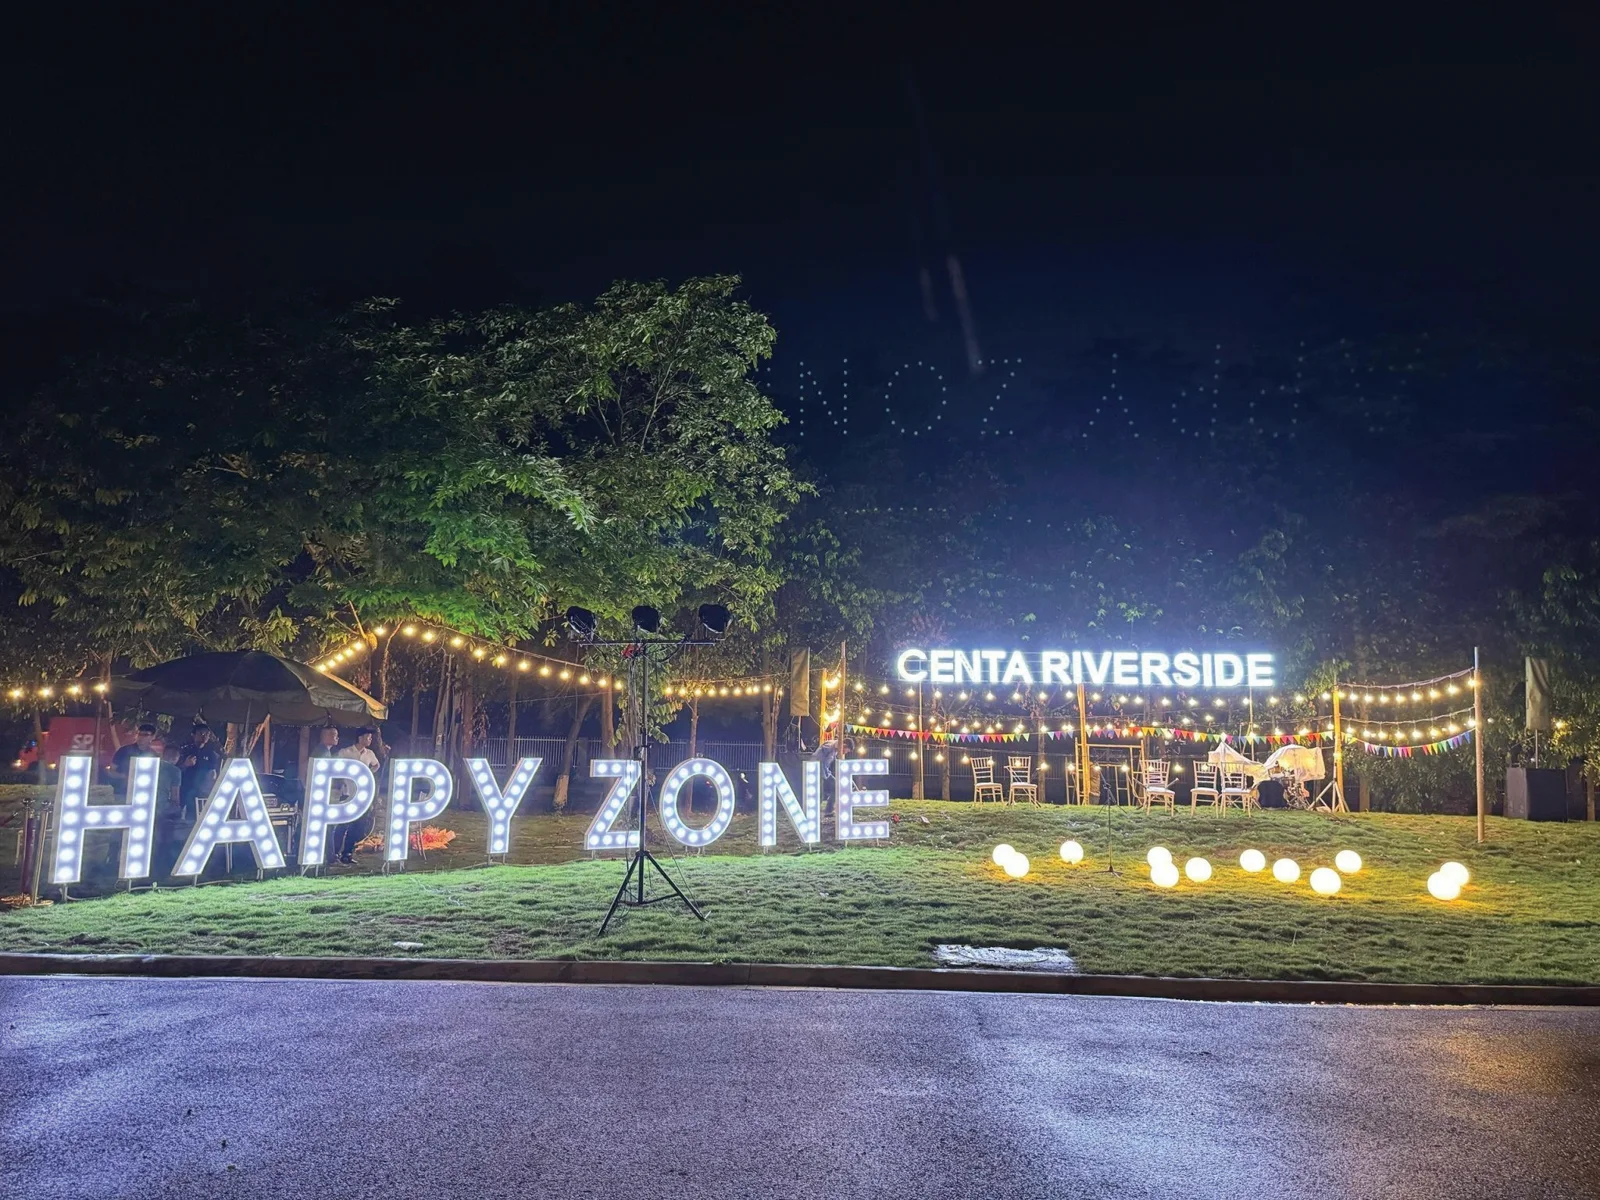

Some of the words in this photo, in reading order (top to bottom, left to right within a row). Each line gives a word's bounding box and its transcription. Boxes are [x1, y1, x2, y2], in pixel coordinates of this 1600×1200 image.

[898, 648, 1033, 685] CENTA
[1042, 650, 1275, 687] RIVERSIDE
[48, 756, 543, 884] HAPPY
[584, 757, 890, 850] ZONE
